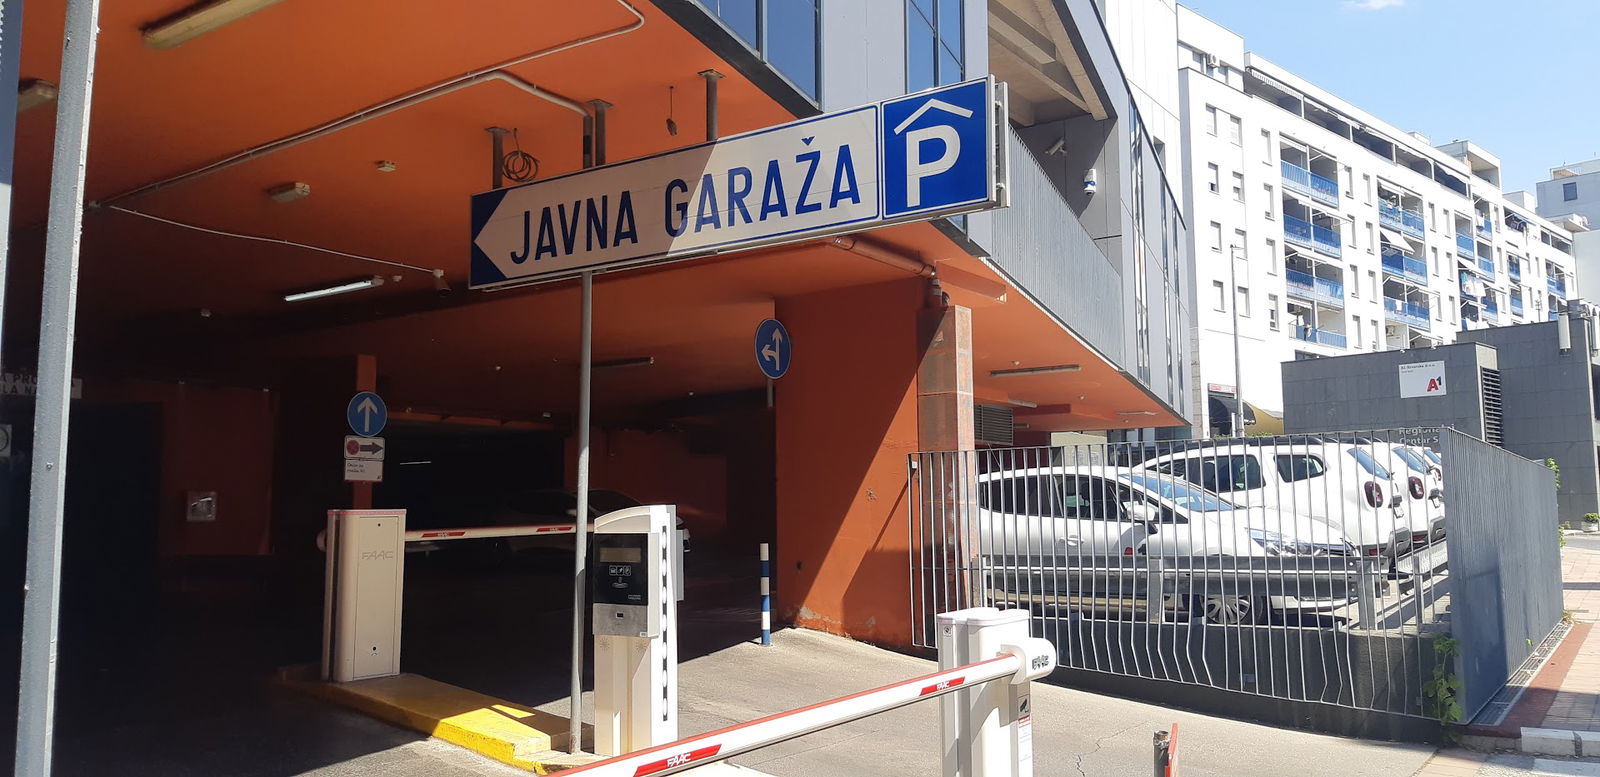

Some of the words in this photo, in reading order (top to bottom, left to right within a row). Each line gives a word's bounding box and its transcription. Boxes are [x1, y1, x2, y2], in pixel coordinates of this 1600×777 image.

[906, 124, 961, 208] P
[510, 190, 639, 265] JAVNA
[665, 136, 861, 237] GARAŽA
[1427, 376, 1442, 392] A1
[361, 550, 393, 560] FAAC
[667, 752, 691, 767] FAAC
